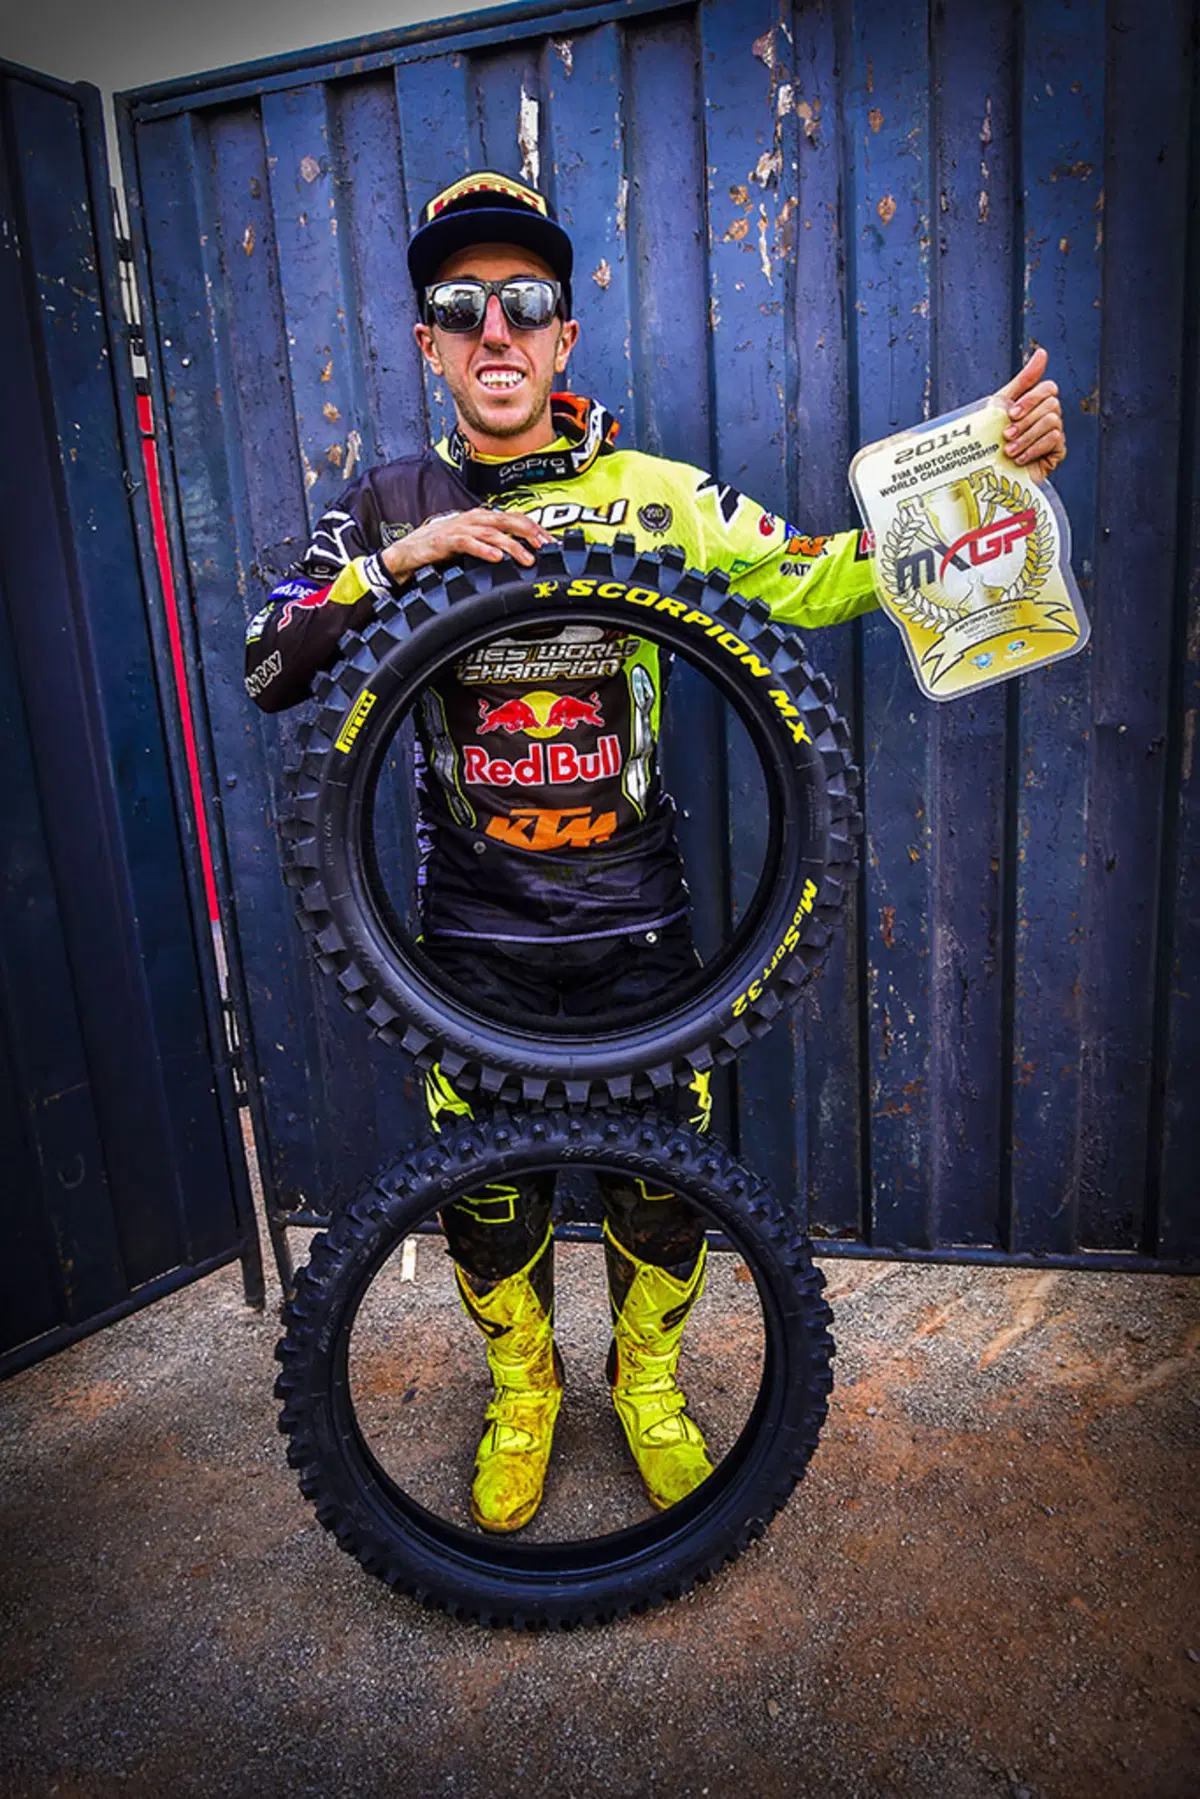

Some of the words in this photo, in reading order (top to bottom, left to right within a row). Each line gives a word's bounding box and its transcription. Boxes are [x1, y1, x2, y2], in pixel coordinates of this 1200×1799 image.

[891, 468, 912, 483] FIM
[913, 441, 982, 475] MOTOCROSS
[894, 423, 971, 465] 2014
[879, 476, 918, 498] WORLD
[920, 443, 1000, 481] CHAMPIONSHIP
[896, 506, 1037, 595] MXGP
[460, 657, 621, 683] CHAMPION
[536, 639, 642, 662] WORLD
[566, 578, 772, 678] SCORPION
[768, 689, 814, 745] MX
[334, 689, 377, 754] PIRELLI
[463, 743, 544, 786] Red
[549, 735, 622, 783] Bull
[485, 806, 617, 850] KTM
[731, 979, 763, 1017] 32
